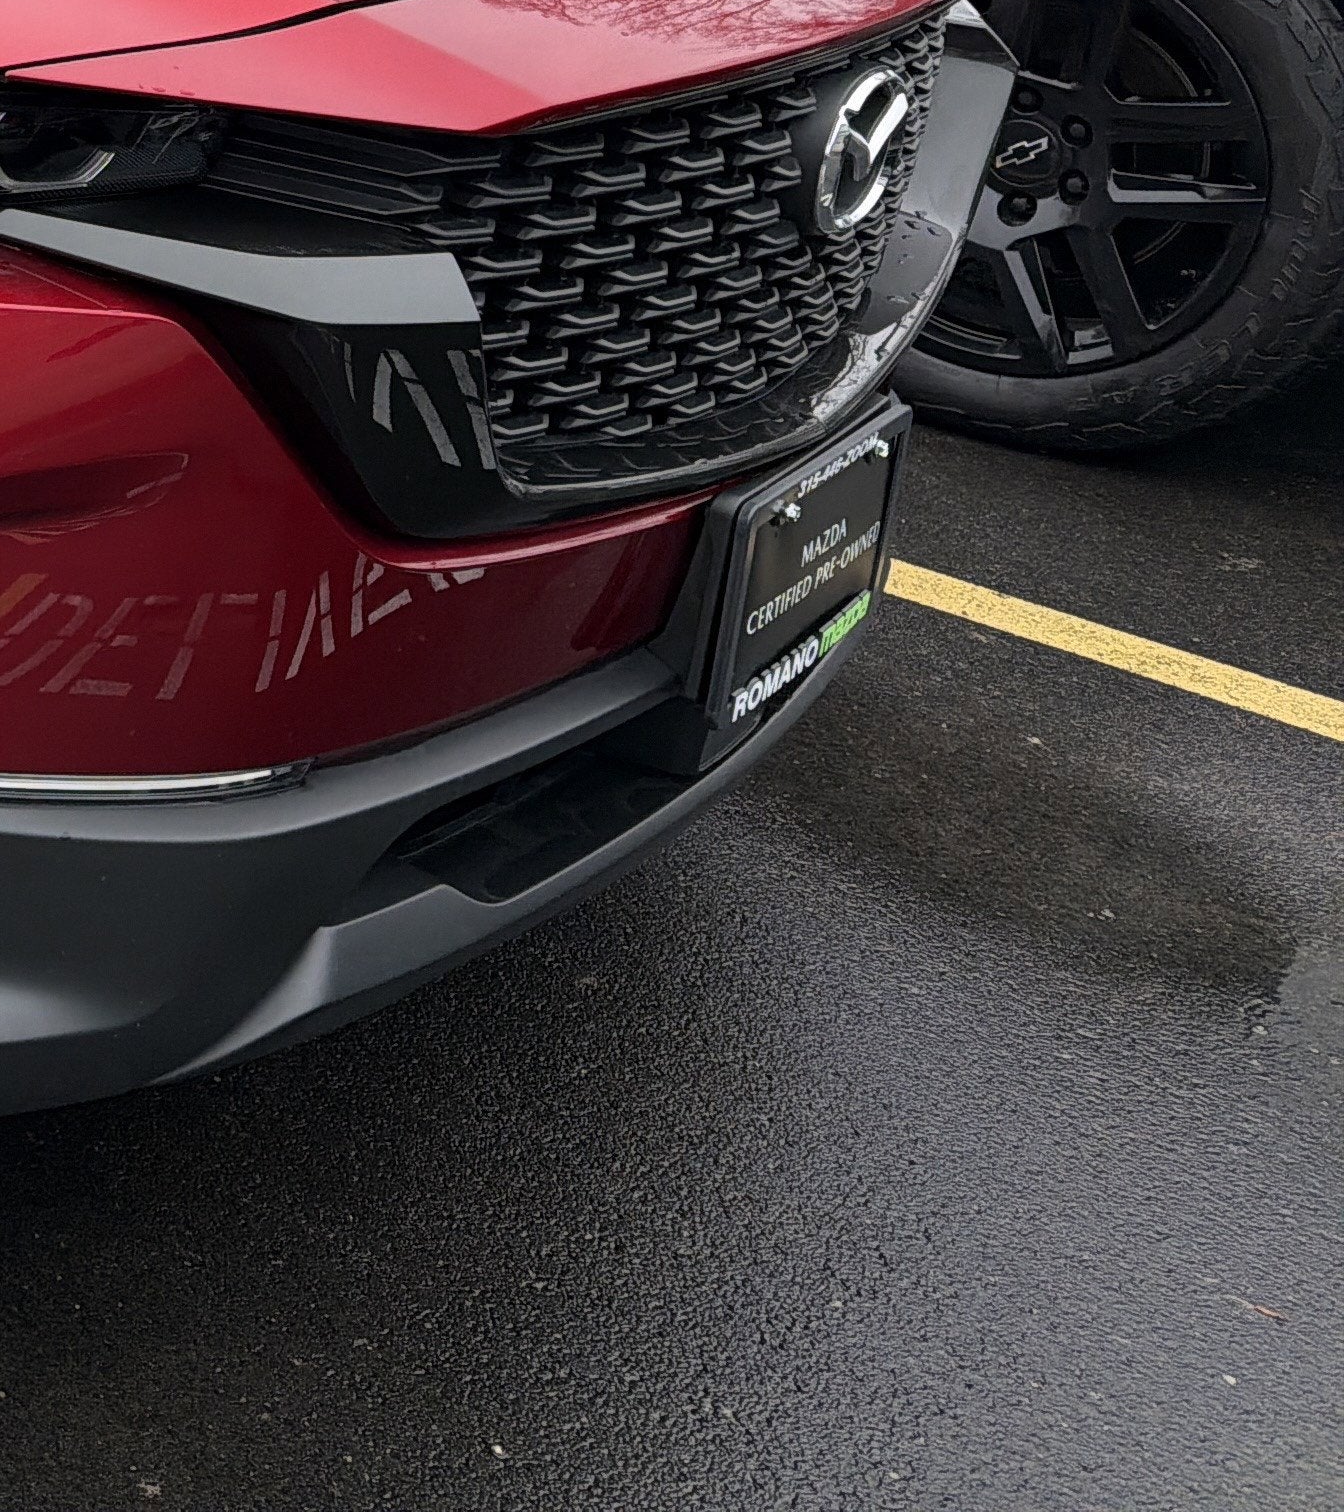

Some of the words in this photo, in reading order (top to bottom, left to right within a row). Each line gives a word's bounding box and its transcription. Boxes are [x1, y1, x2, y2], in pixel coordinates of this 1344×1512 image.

[746, 575, 813, 636] CERTIFIED
[814, 520, 881, 591] PRE-OWNED
[800, 518, 848, 568] MAZDA
[731, 637, 819, 723] ROMANO
